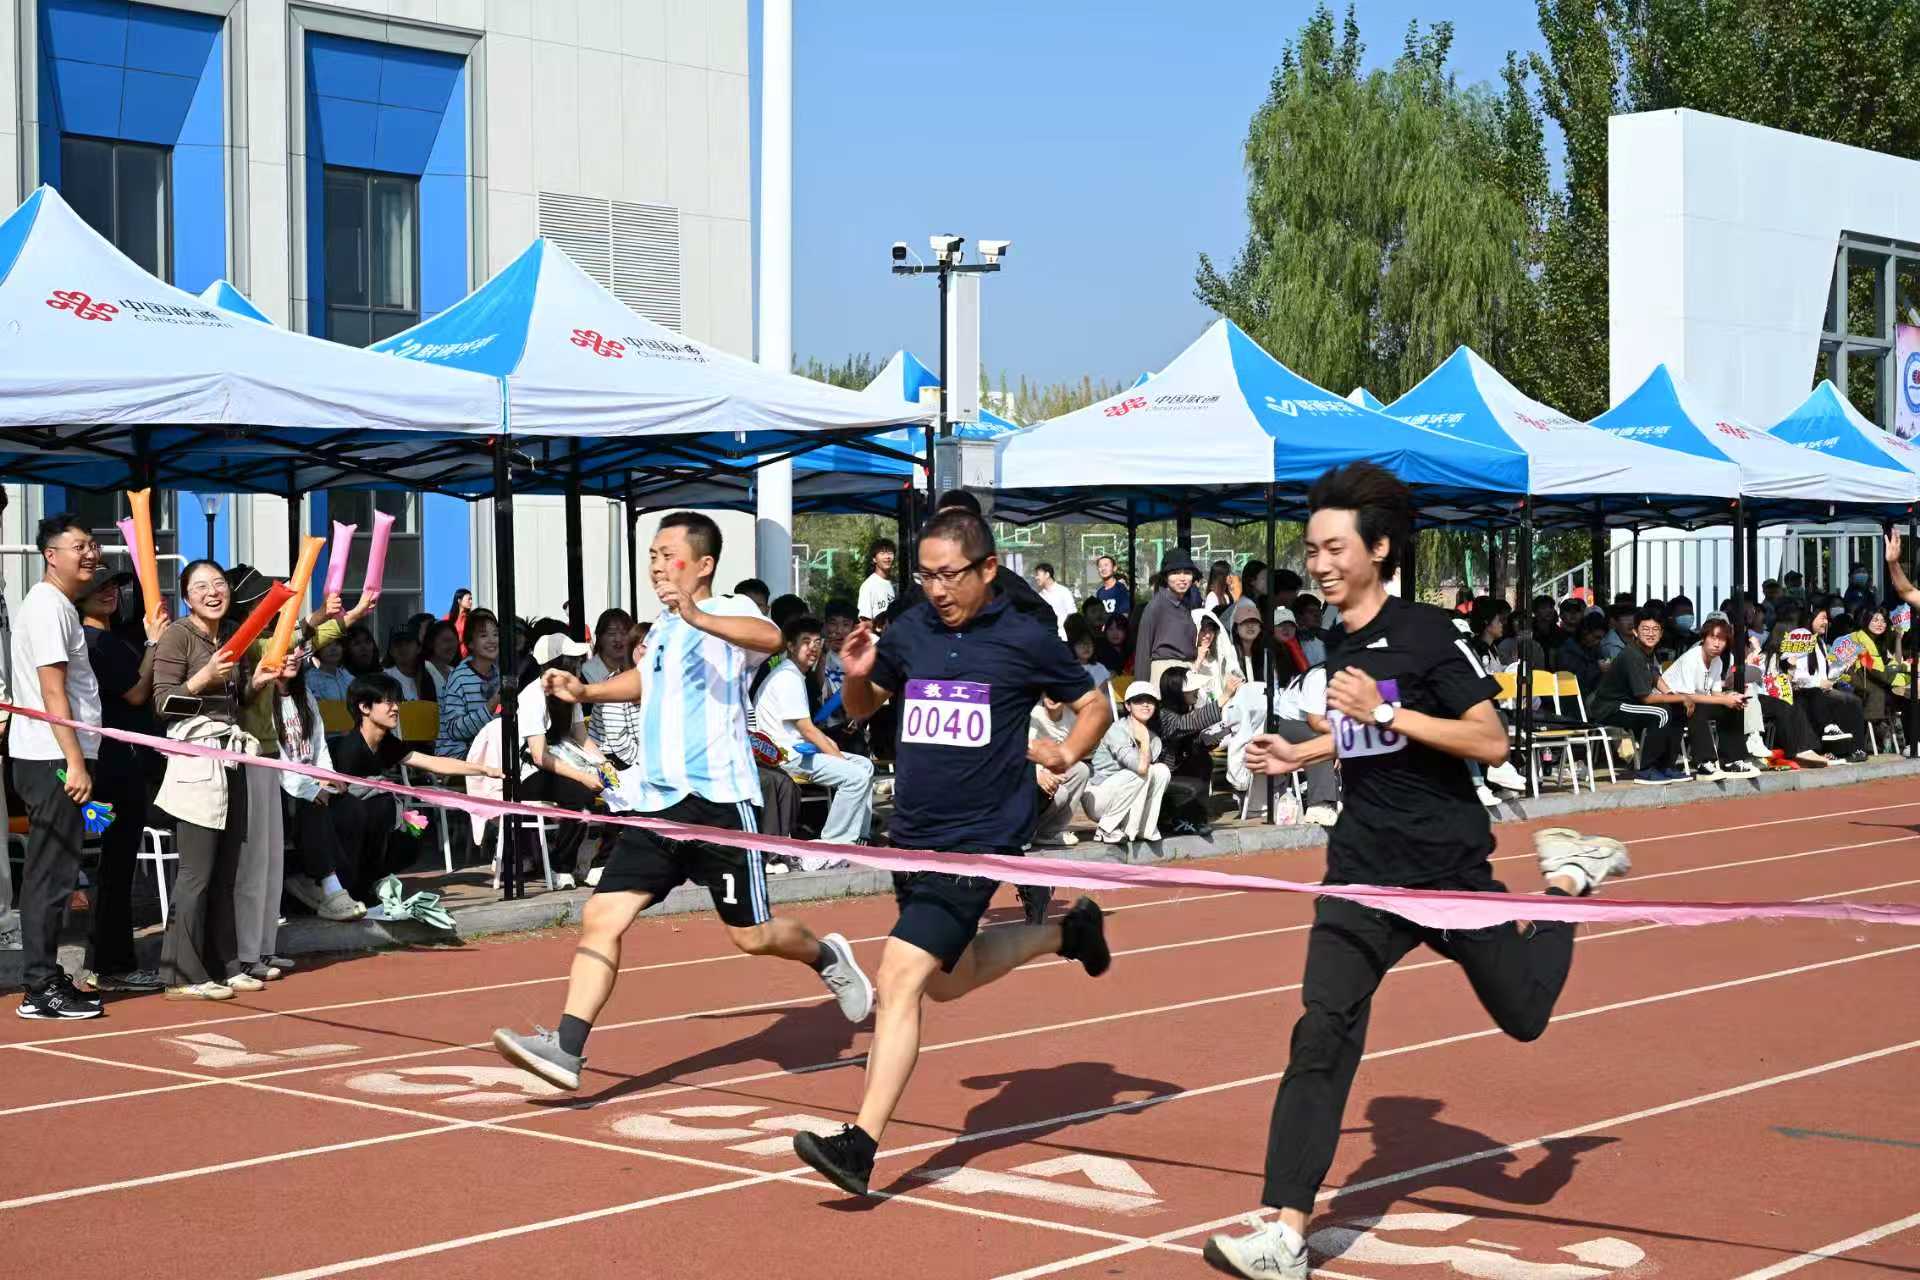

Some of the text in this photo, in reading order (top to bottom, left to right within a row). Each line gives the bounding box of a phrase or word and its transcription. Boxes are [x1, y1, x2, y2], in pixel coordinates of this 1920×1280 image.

[118, 299, 220, 320] 中国联通
[622, 336, 702, 356] 中国联通
[907, 705, 984, 741] 0040
[722, 873, 738, 905] 1
